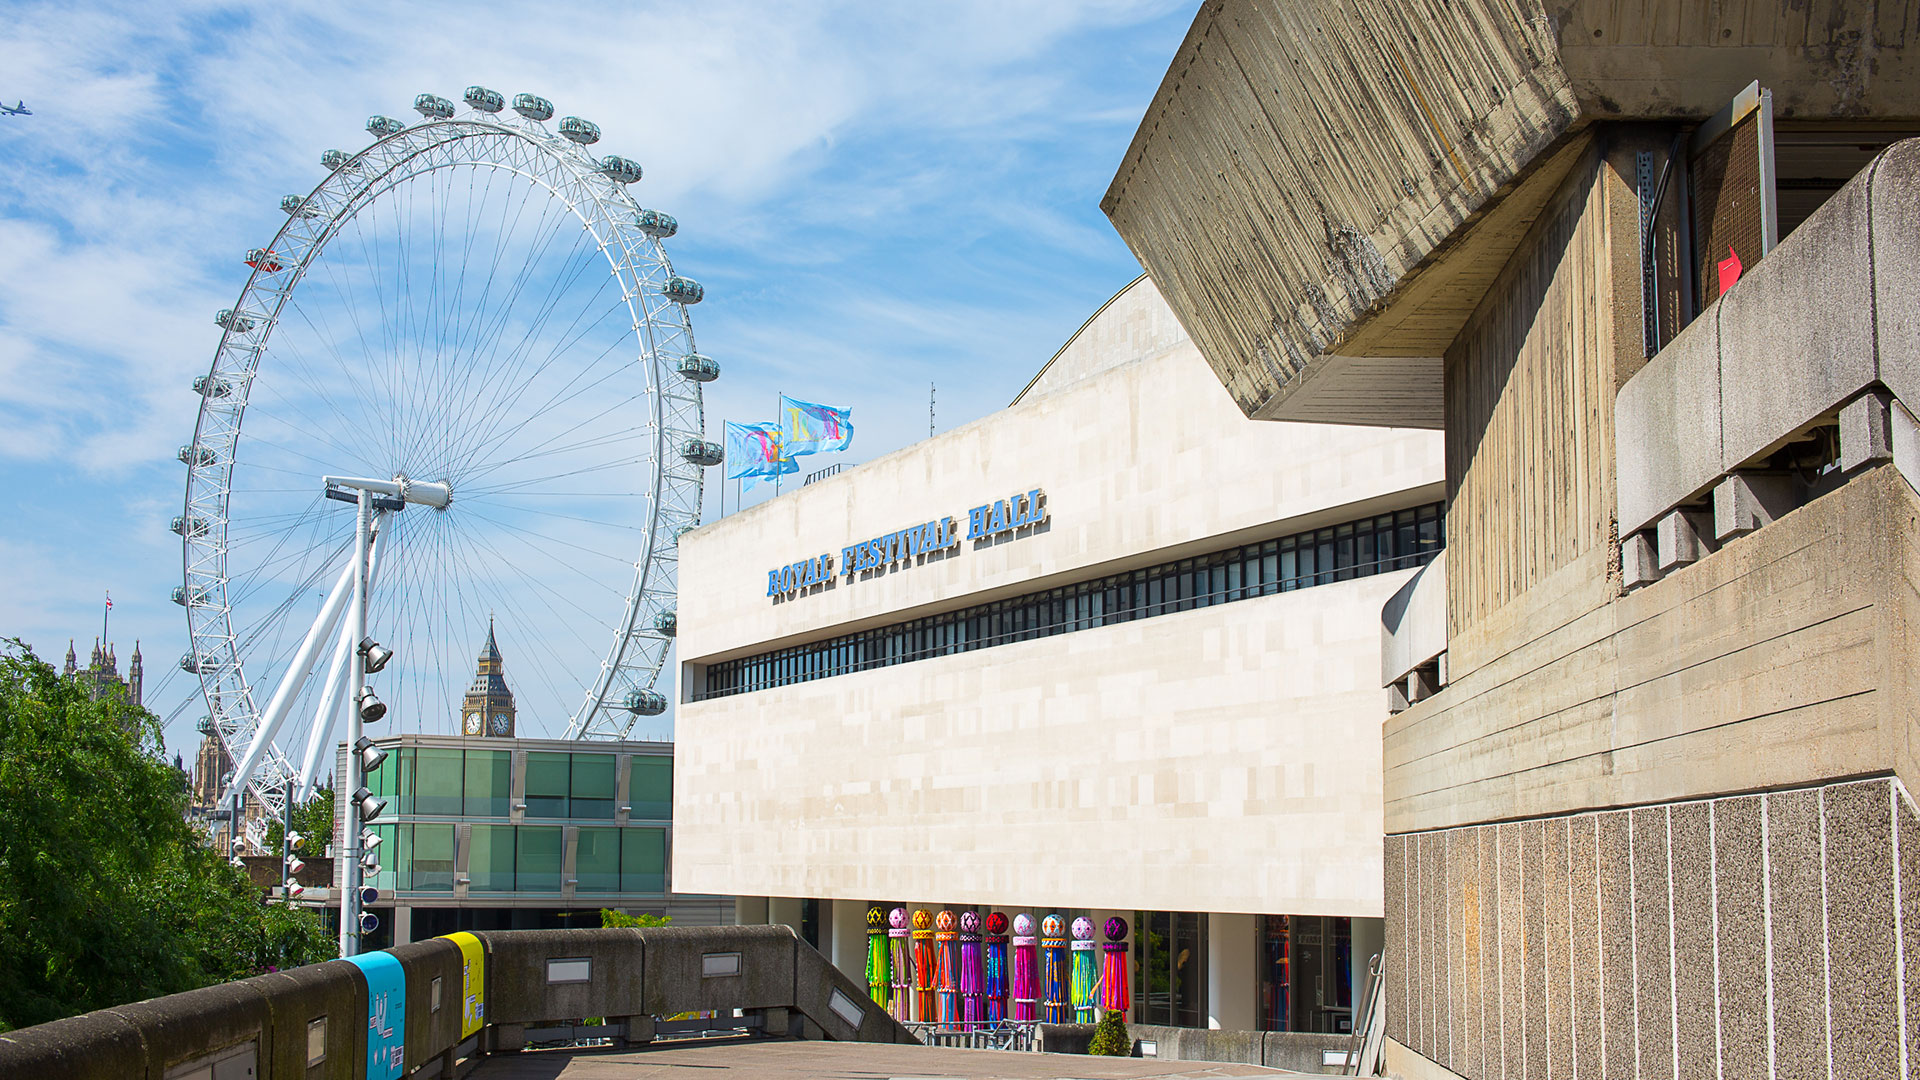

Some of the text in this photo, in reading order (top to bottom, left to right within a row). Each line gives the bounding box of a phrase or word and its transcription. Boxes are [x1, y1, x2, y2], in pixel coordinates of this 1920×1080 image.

[766, 488, 1048, 597] ROYAL FESTIVAL HALL
